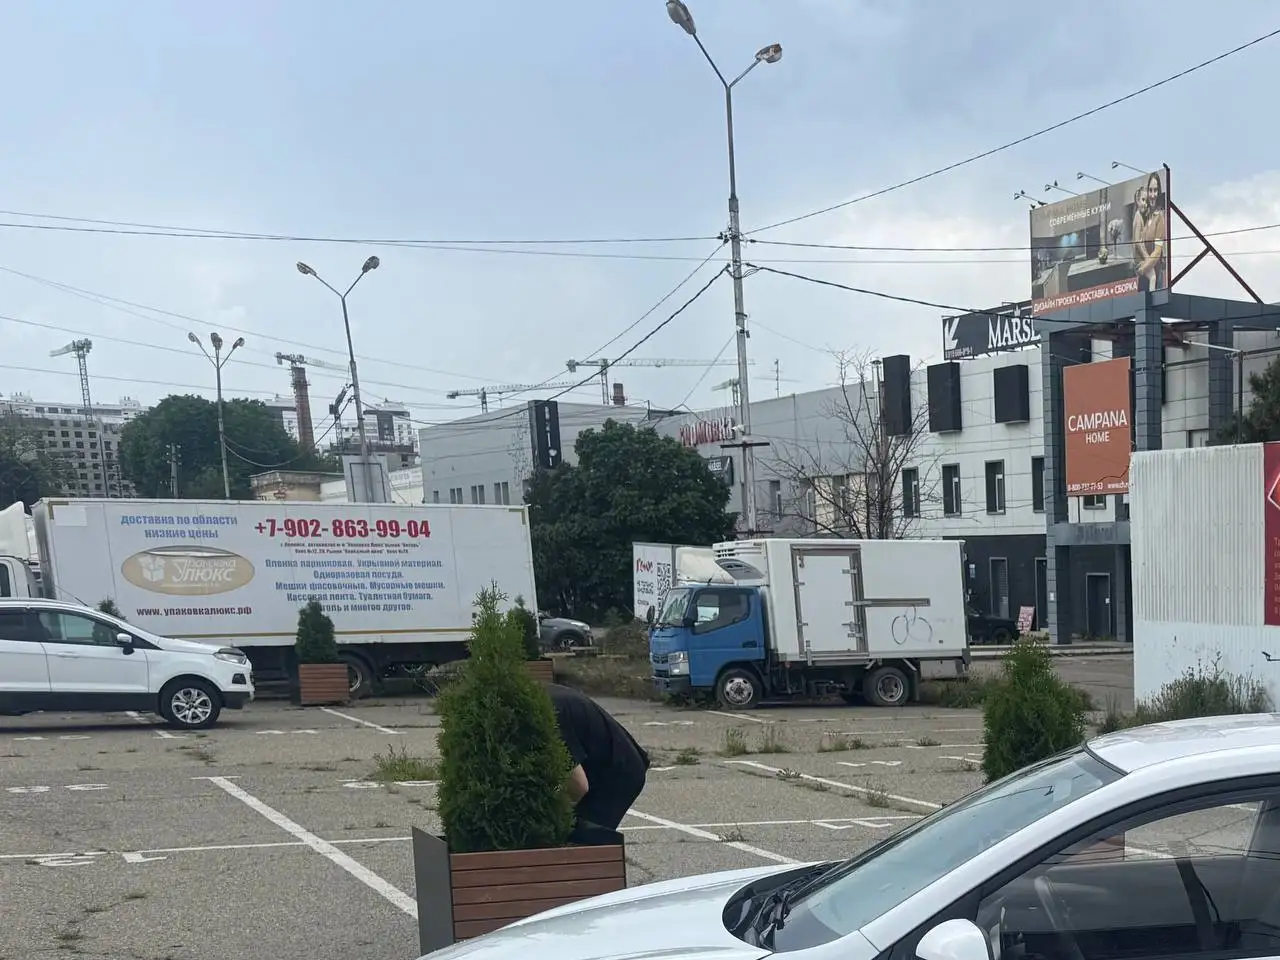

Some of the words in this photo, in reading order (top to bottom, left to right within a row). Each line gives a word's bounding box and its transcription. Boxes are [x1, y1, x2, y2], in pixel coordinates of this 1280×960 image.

[1050, 208, 1090, 227] СОВРЕМЕННЫЕ
[1091, 202, 1111, 215] КУХНИ
[1034, 297, 1055, 312] ДИЗАЙН
[1056, 294, 1076, 307] ПРОЕКТ
[1080, 288, 1109, 303] ДОСТАВКА
[1115, 282, 1138, 295] СБОРКА
[1068, 409, 1128, 432] CAMPANA
[1086, 431, 1110, 444] HOME
[120, 514, 174, 525] доставка
[176, 516, 190, 525] по
[192, 514, 238, 525] области
[144, 529, 186, 538] низкие
[189, 530, 218, 539] цены
[254, 519, 328, 537] +7-902-
[332, 519, 431, 538] 863-99-04
[265, 559, 298, 568] Пленка
[357, 559, 399, 568] Укрывной
[313, 571, 371, 580] Одноразовая
[372, 571, 404, 580] посуда.
[275, 582, 307, 590] Мешки
[309, 582, 368, 590] фасовочные.
[370, 582, 414, 590] Мусорные
[414, 582, 446, 590] мешки.
[287, 593, 328, 602] Кассовая
[330, 593, 357, 601] лента.
[359, 592, 402, 601] Туалетная
[402, 592, 434, 601] бумага.
[137, 608, 162, 616] www.
[165, 606, 252, 617] упаковкалюкс.рф
[382, 604, 413, 612] другое.
